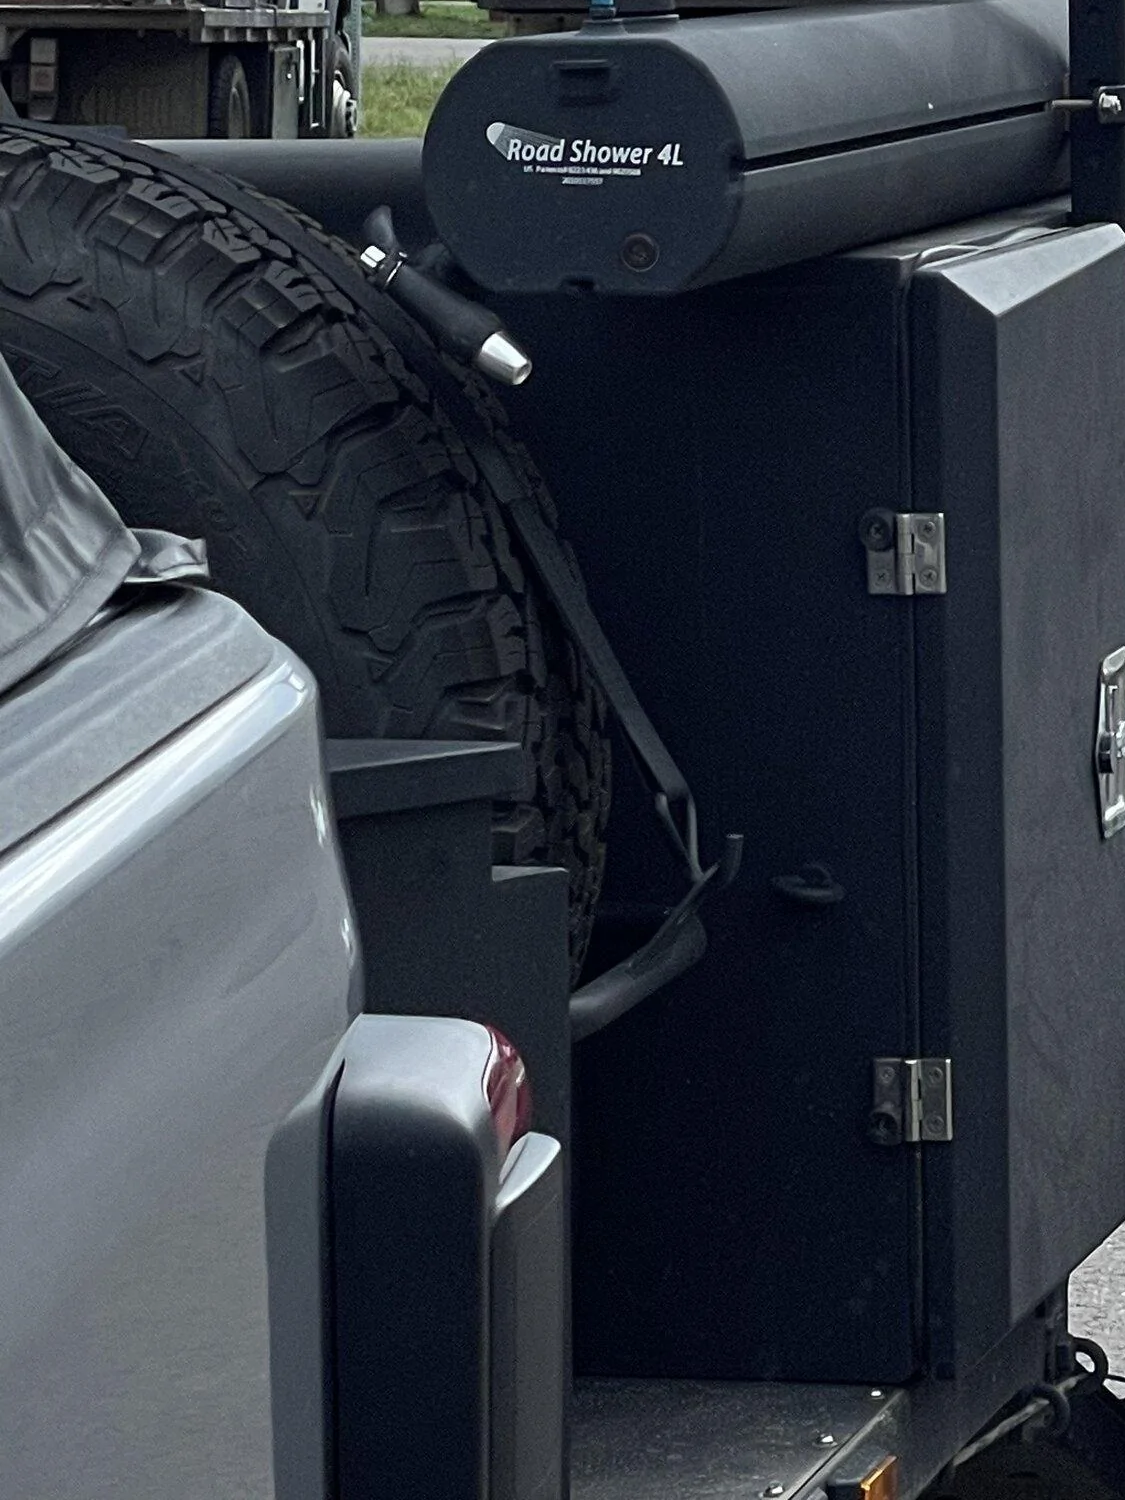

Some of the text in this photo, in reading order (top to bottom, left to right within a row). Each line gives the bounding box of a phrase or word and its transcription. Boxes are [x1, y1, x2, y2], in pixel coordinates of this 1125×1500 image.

[508, 139, 684, 166] Road Shower 4L
